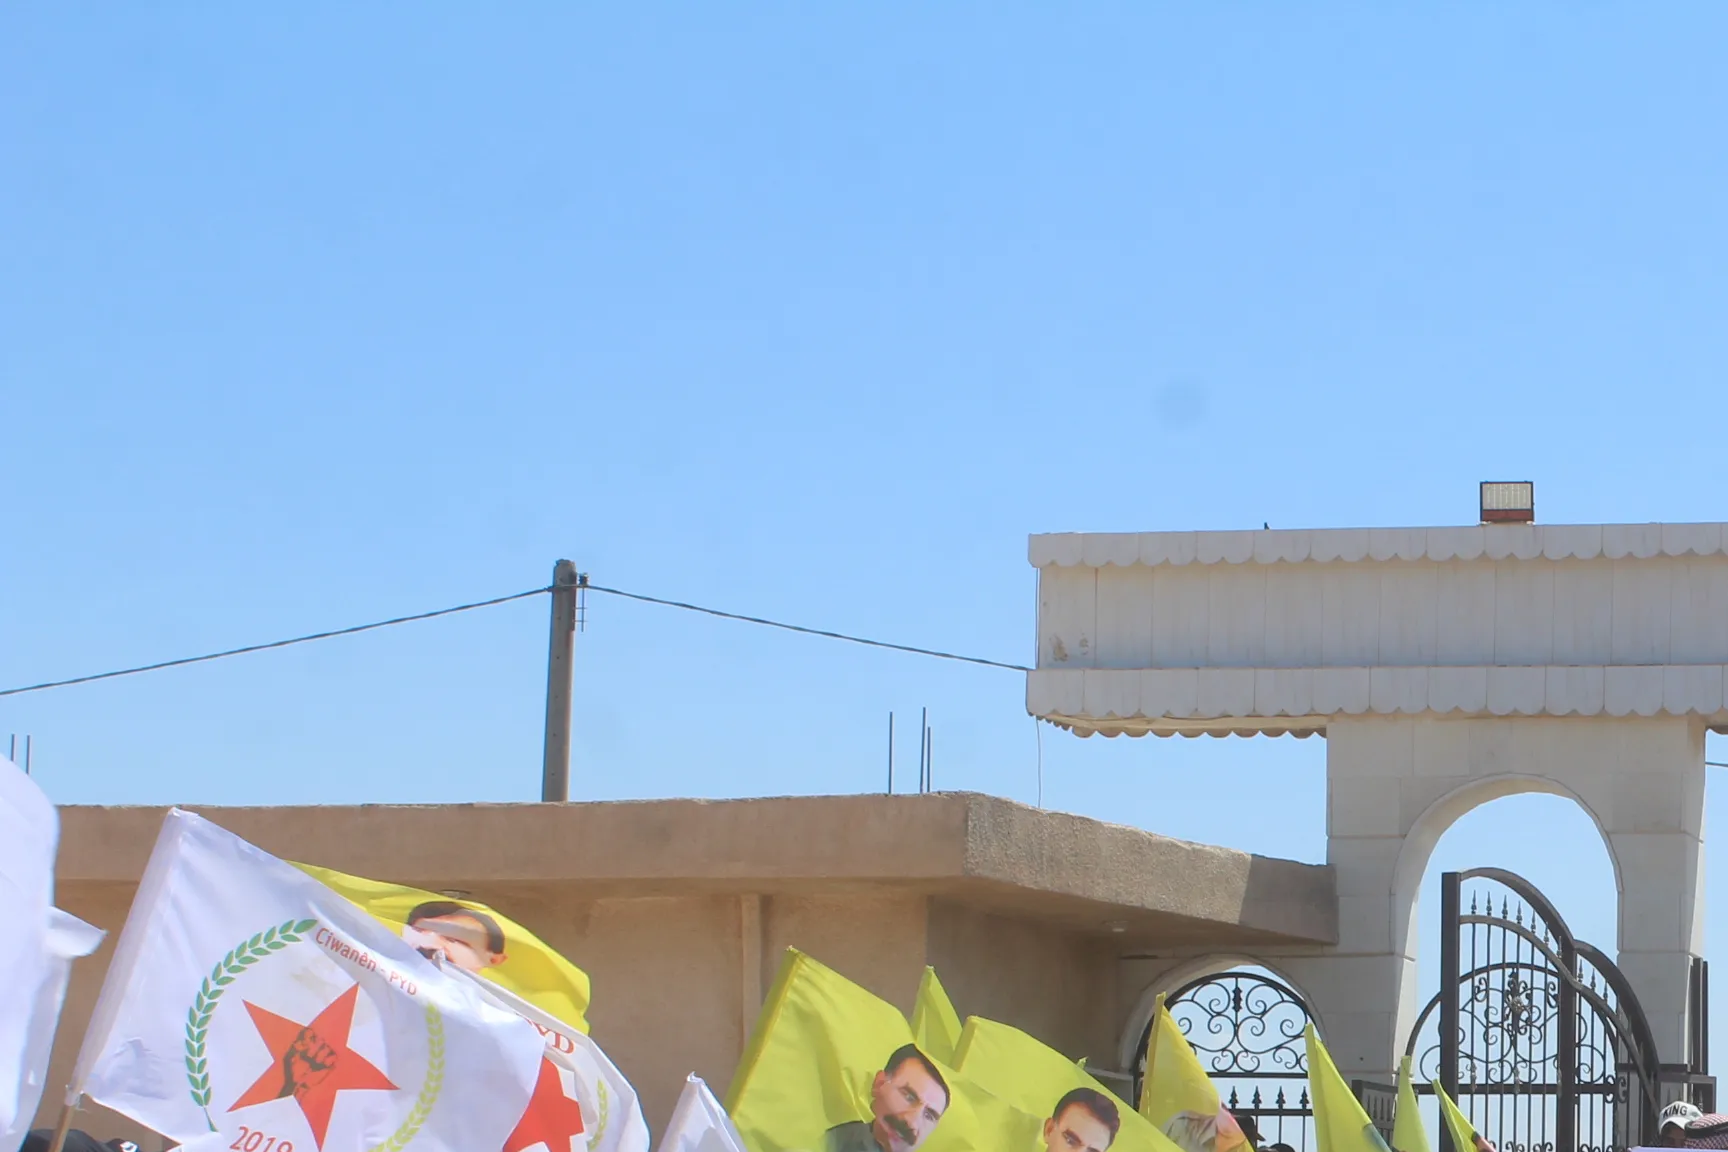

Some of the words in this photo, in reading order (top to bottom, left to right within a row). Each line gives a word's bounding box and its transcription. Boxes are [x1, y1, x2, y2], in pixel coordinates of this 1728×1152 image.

[316, 927, 377, 973] Ciwanên
[389, 970, 418, 996] PYD
[523, 1014, 574, 1054] YD
[1662, 1104, 1688, 1119] KING
